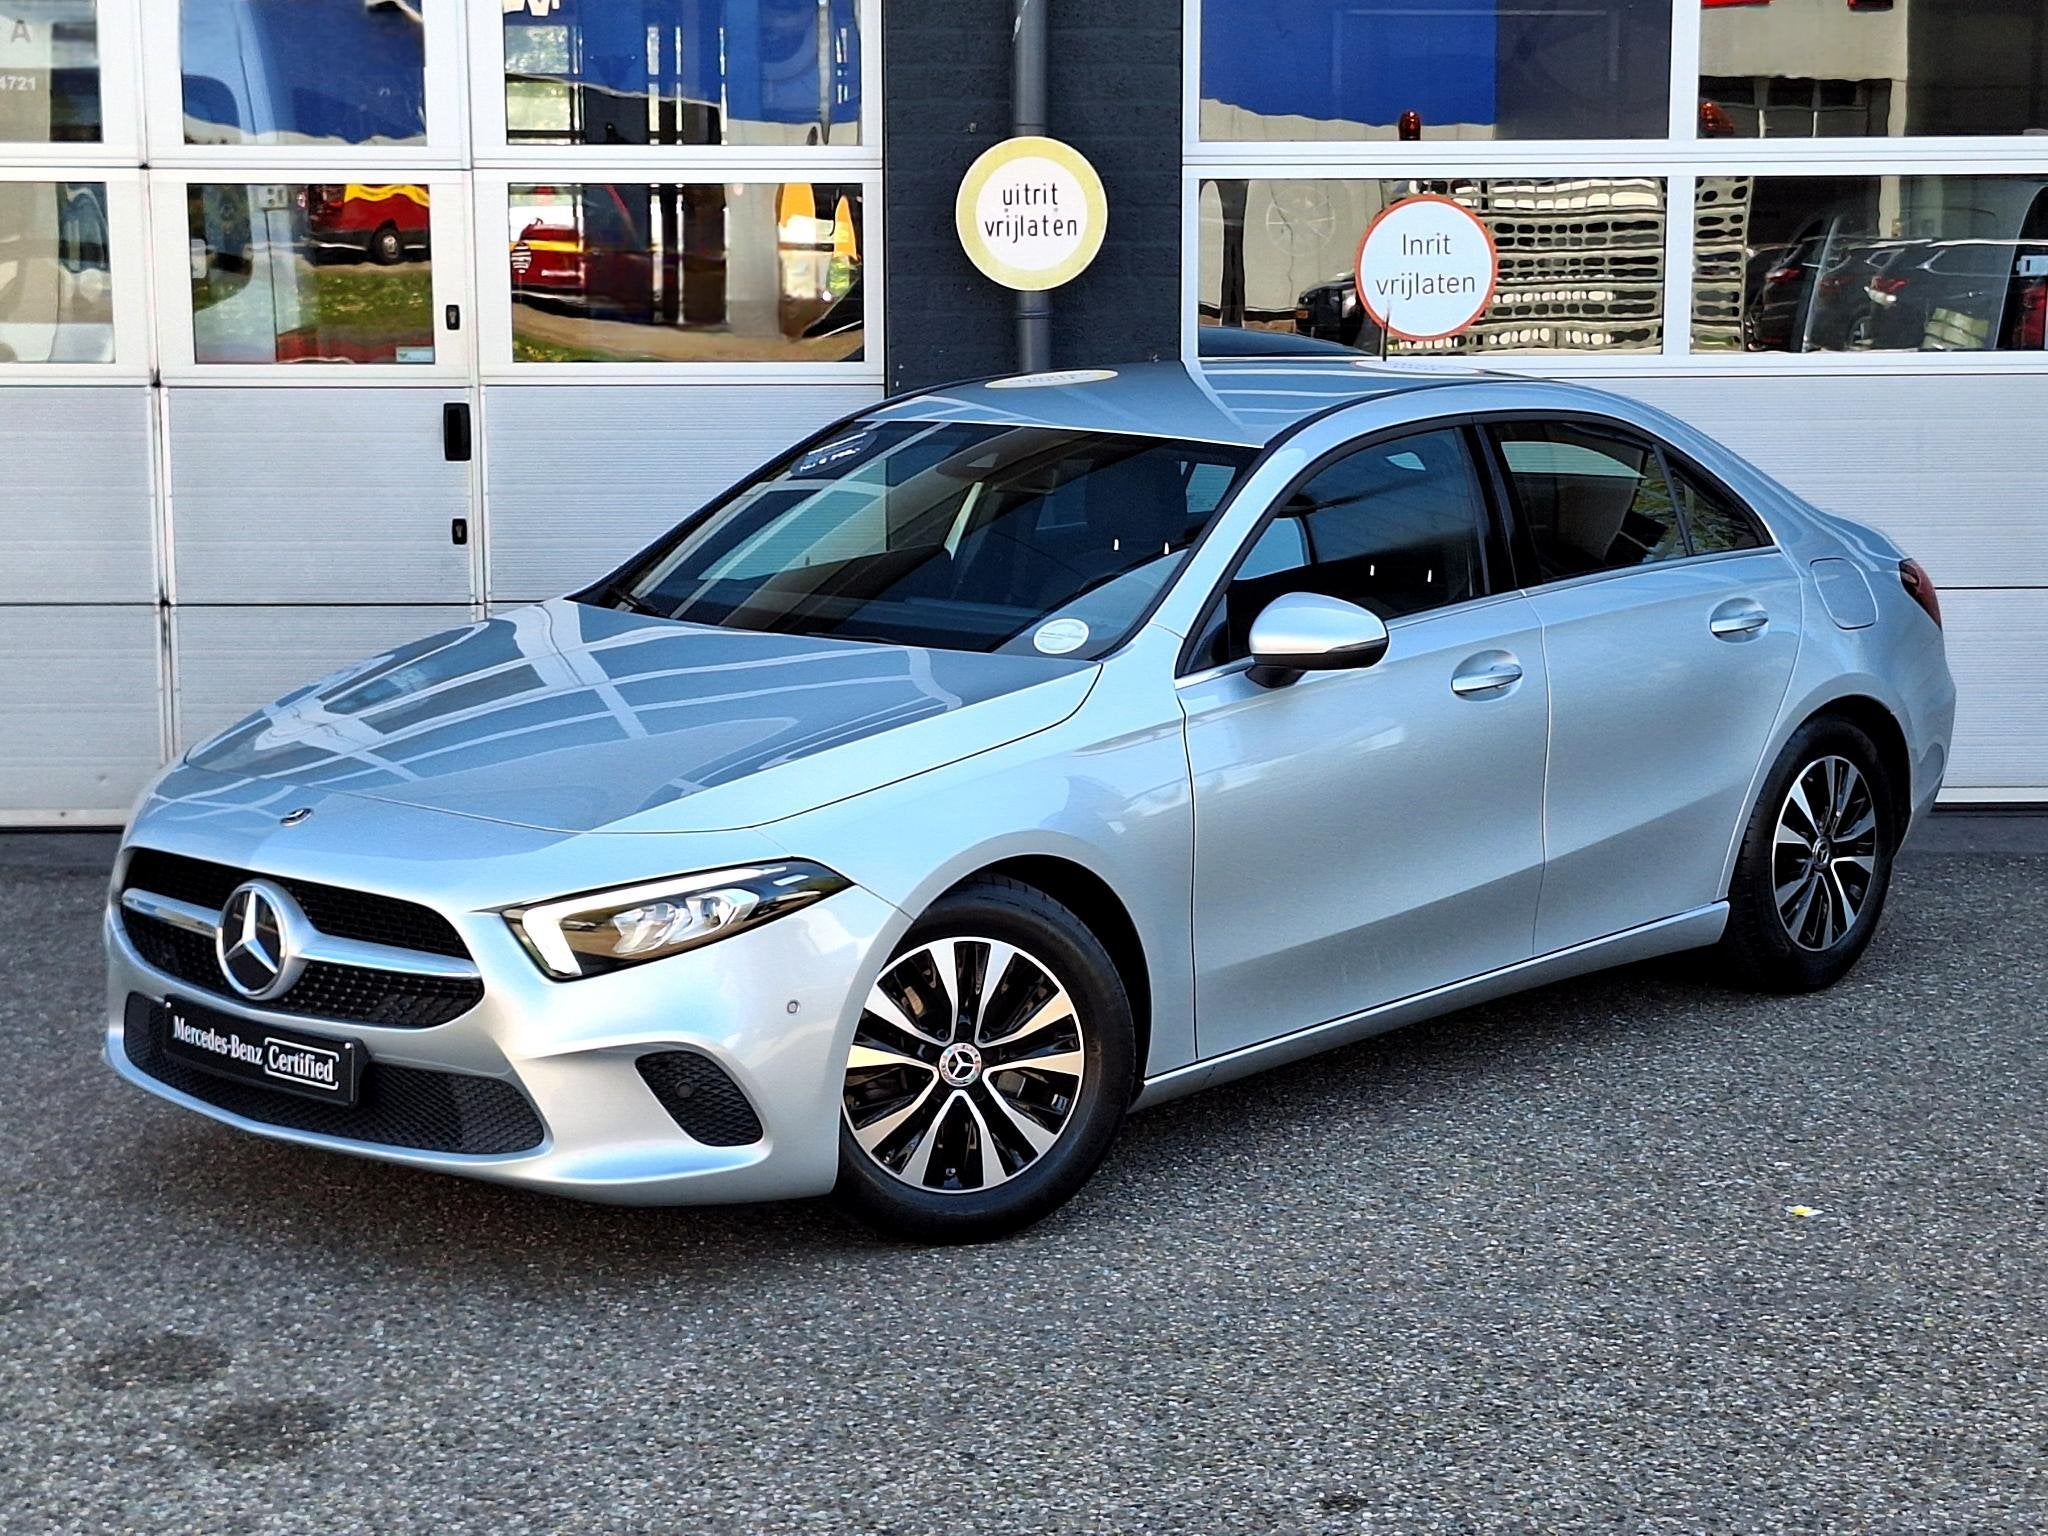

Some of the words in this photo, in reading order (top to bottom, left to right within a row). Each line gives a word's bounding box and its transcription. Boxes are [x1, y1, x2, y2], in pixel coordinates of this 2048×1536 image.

[1002, 183, 1058, 206] uitrit
[984, 213, 1078, 244] vrijlaten
[1402, 232, 1451, 256] Inrit
[1375, 272, 1476, 301] vrijlaten
[172, 1014, 264, 1067] Mercedes-Benz
[268, 1045, 335, 1083] Certified
